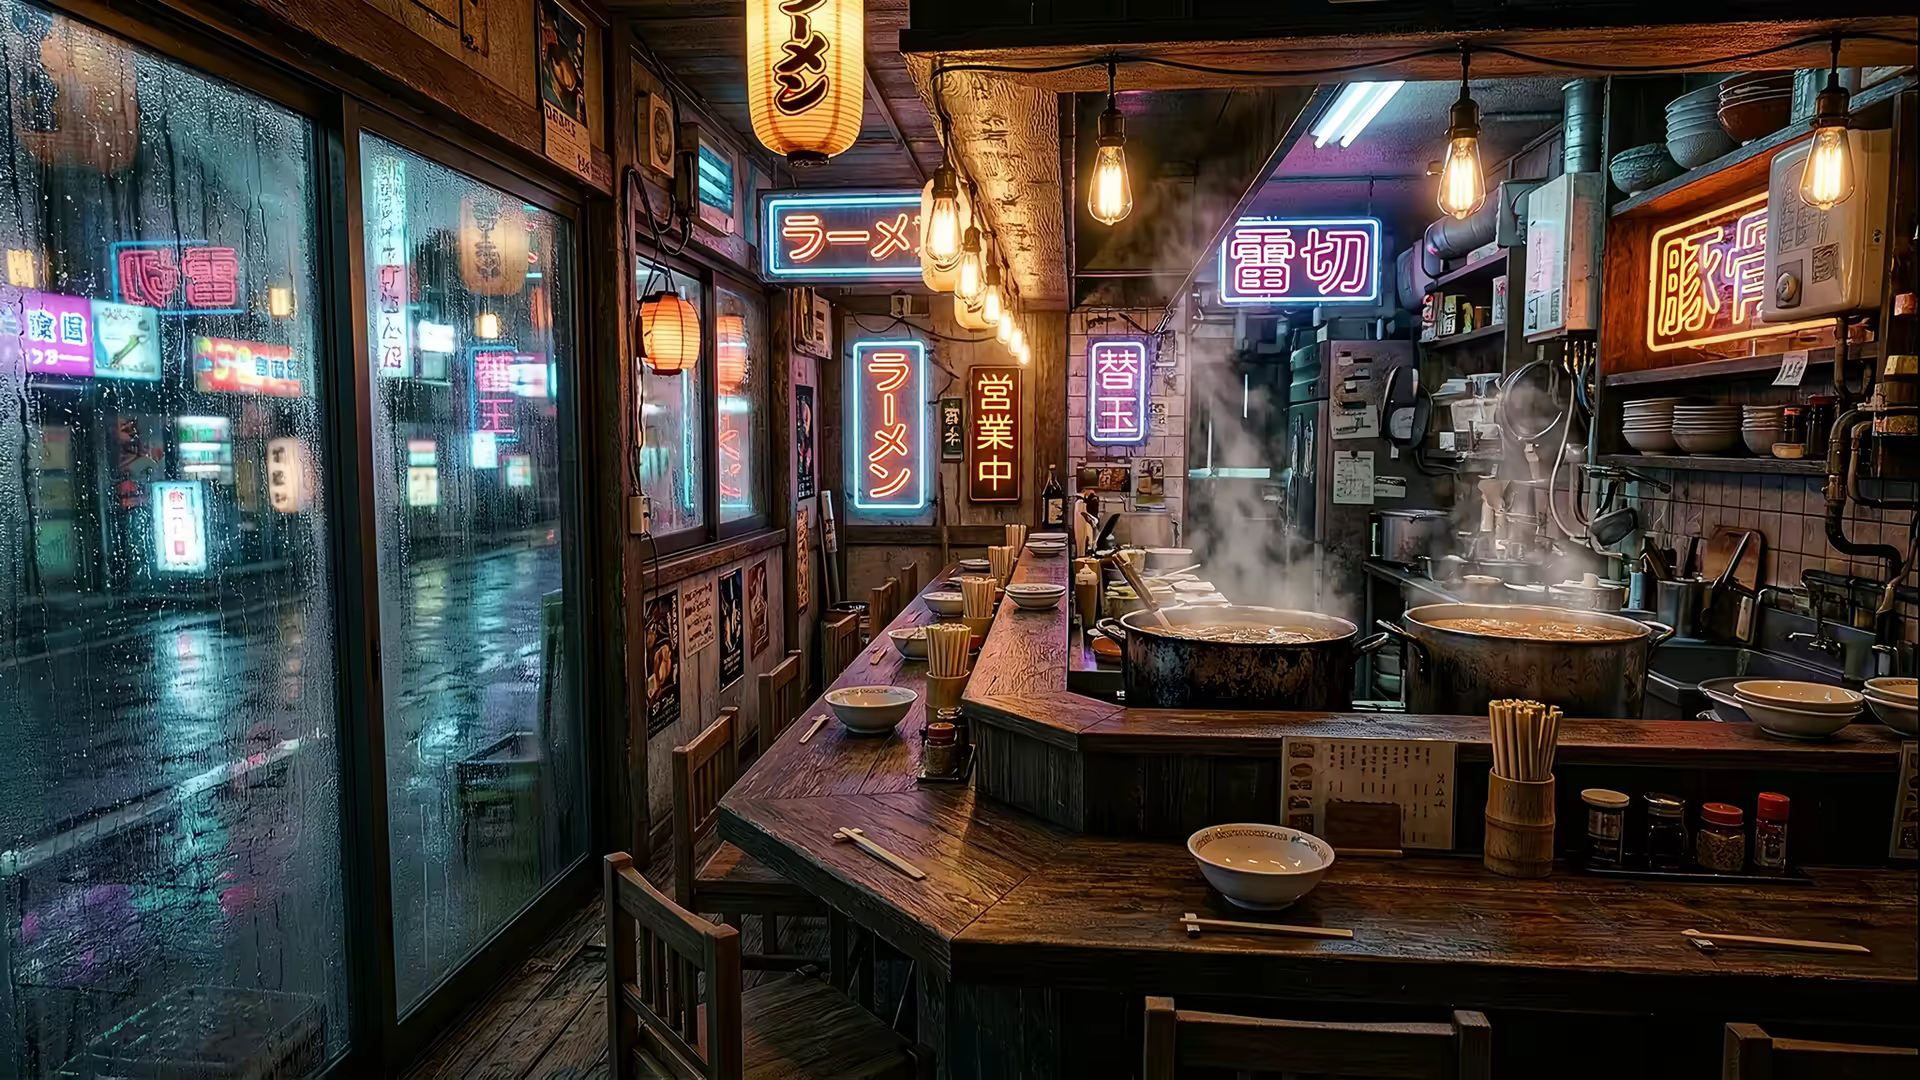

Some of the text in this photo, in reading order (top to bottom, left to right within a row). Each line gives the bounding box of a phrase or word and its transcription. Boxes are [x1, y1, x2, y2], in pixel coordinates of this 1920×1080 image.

[782, 213, 921, 262] ラーメ
[1230, 228, 1369, 295] 雷切
[868, 353, 911, 498] ラーメン
[976, 373, 1014, 491] 営業中
[1098, 349, 1138, 433] 替玉
